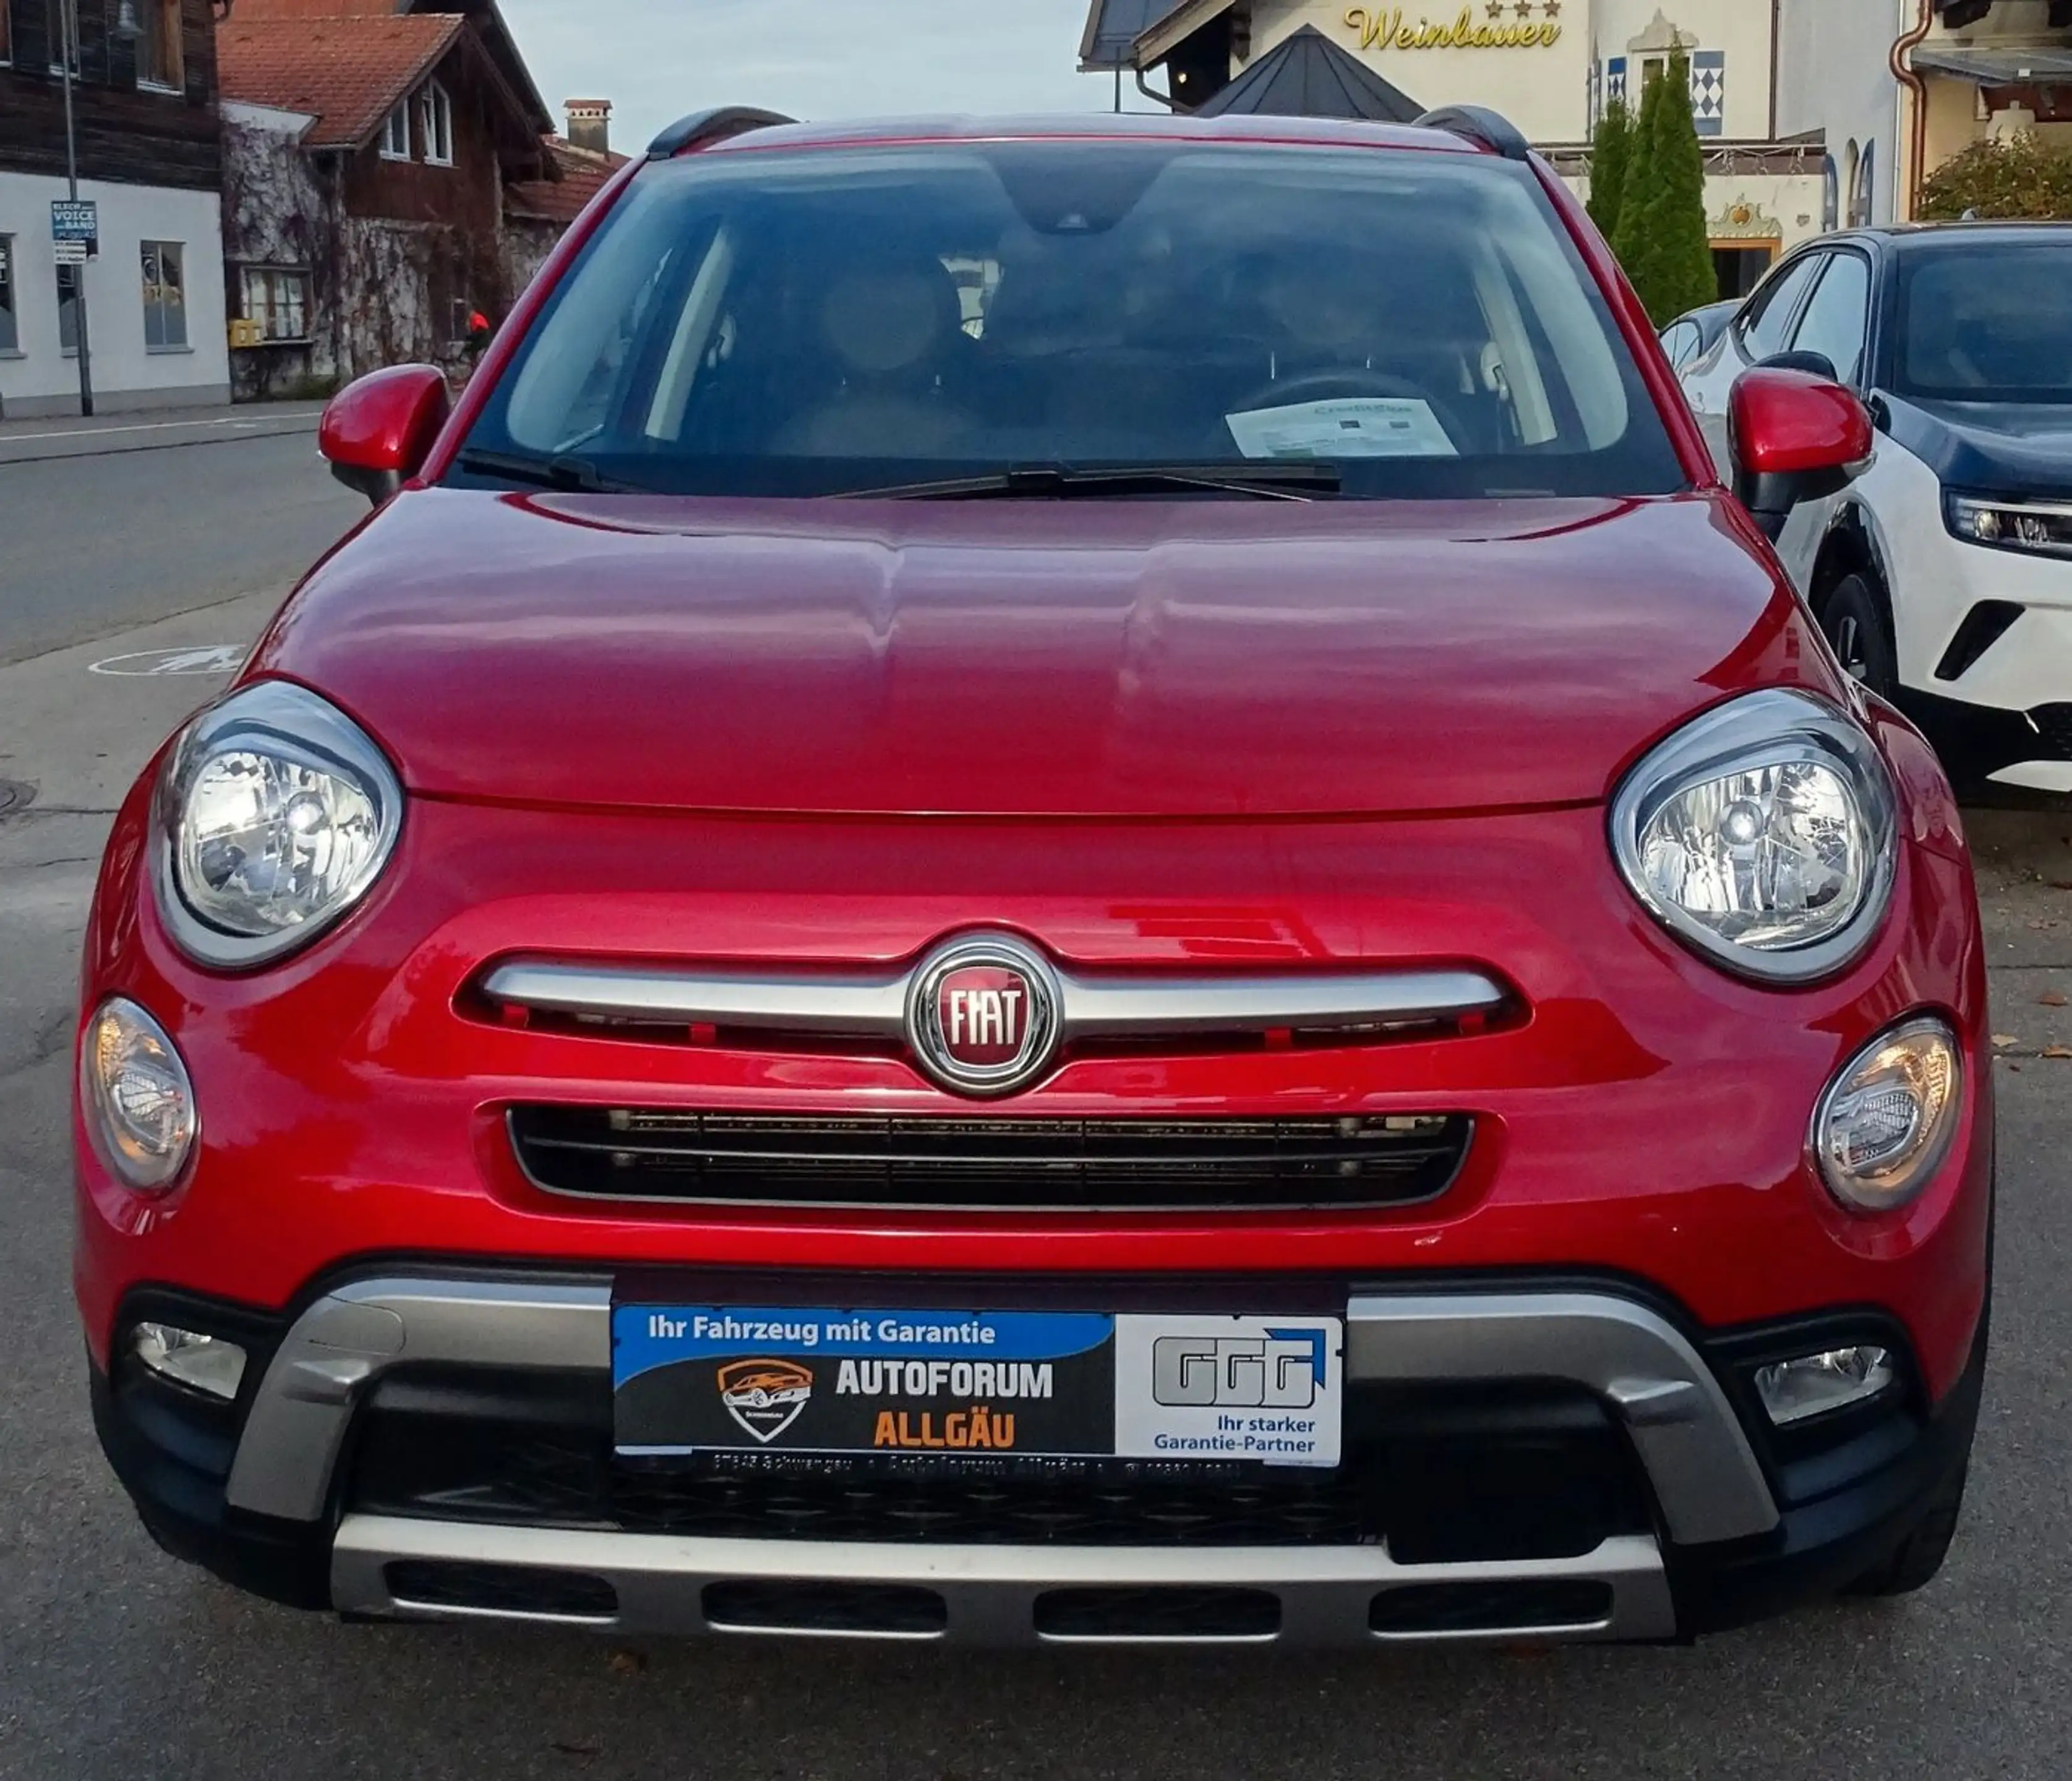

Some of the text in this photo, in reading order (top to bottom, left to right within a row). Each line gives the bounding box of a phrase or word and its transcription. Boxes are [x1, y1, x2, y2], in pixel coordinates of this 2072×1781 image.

[1344, 6, 1562, 50] Weinbauer
[54, 211, 95, 221] VOICE
[65, 221, 95, 229] BAND
[950, 990, 1022, 1045] FIAT
[649, 1315, 996, 1347] Ihr Fahrzeug mit Garantie
[836, 1359, 1053, 1398] AUTOFORUM
[873, 1406, 1014, 1448] ALLGÄU
[1217, 1416, 1316, 1433] Ihr starker
[1154, 1433, 1316, 1453] Garantie-Partner
